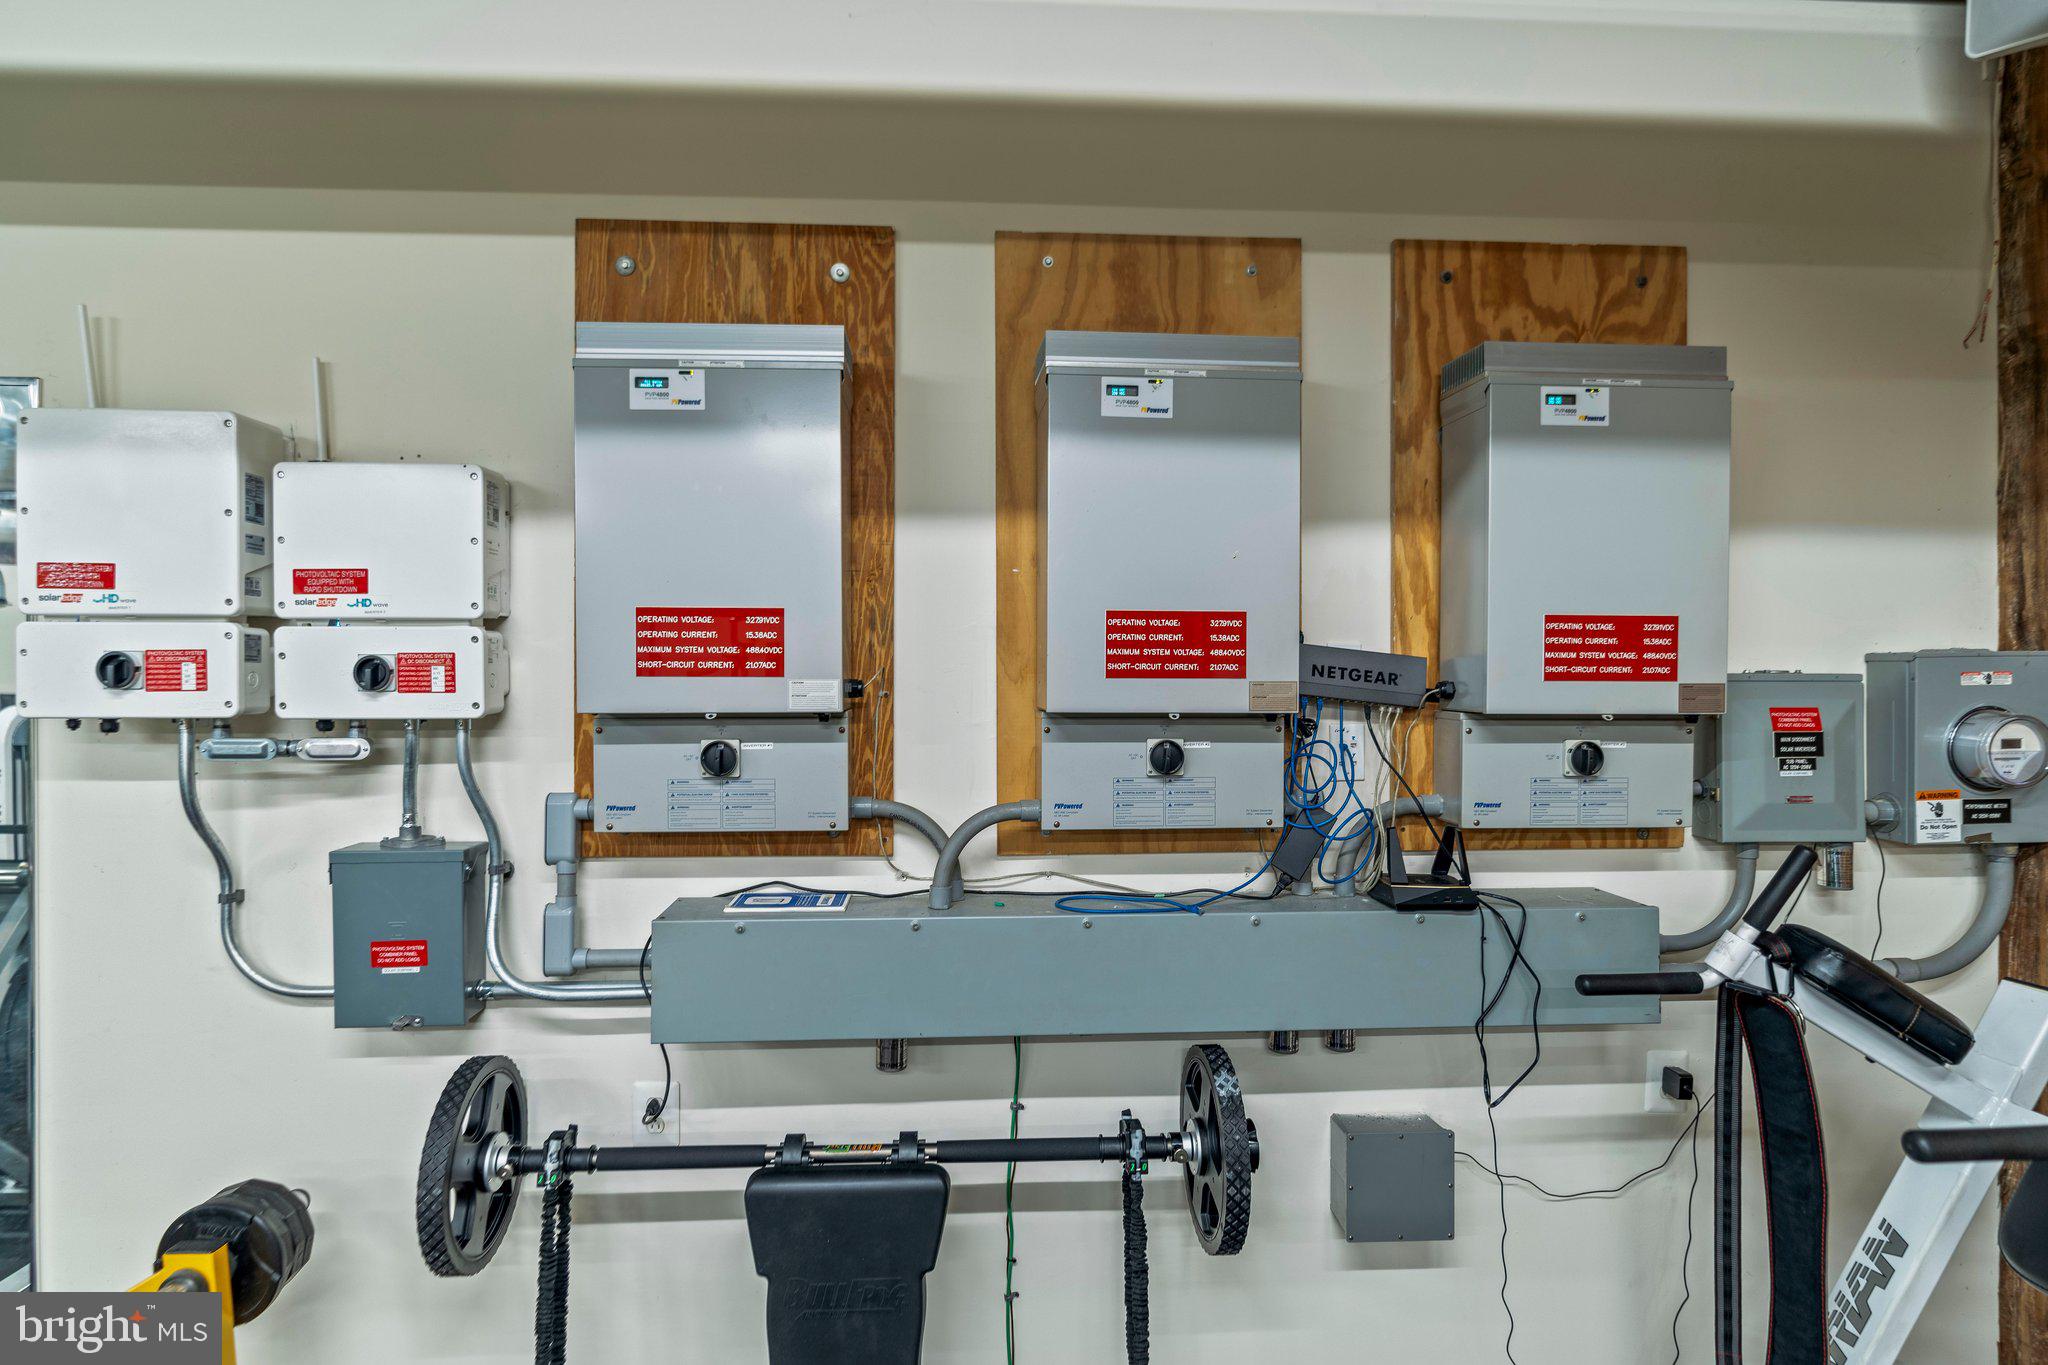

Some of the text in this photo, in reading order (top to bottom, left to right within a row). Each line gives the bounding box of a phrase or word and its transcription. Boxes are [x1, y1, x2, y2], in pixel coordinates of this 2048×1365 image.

[637, 615, 678, 623] OPERATING
[681, 615, 715, 623] VOLTAGE:
[1107, 618, 1146, 626] OPERATING
[1585, 623, 1616, 631] VOLTAGE:
[1107, 633, 1146, 641] OPERATING
[1545, 637, 1582, 645] OPERATING
[1584, 637, 1619, 645] CURRENT:
[707, 646, 740, 654] VOLTAGE:
[1143, 648, 1171, 656] SYSTEM
[698, 661, 735, 669] CURRENT:
[1164, 663, 1199, 671] CURRENT:
[1311, 664, 1399, 687] NETGEAR
